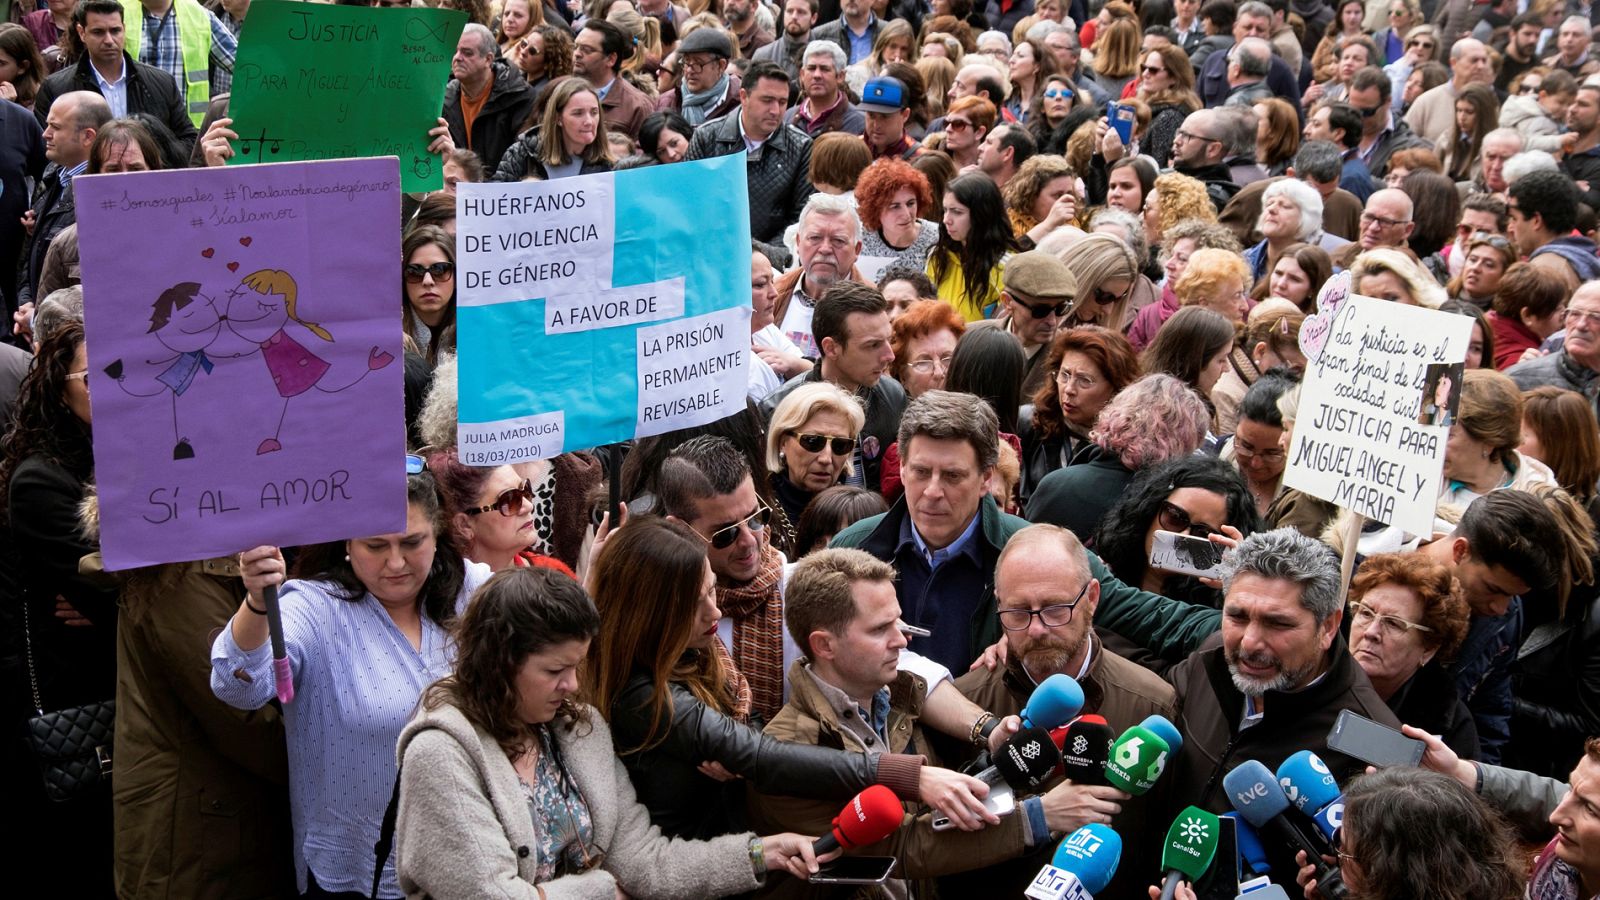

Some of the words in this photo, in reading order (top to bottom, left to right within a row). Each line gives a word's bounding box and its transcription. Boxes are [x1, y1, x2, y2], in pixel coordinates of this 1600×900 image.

[464, 190, 586, 217] HUÉRFANOS
[465, 235, 492, 253] DE
[498, 223, 599, 251] VIOLENCIA
[466, 271, 492, 289] DE
[498, 260, 576, 285] GÉNERO
[551, 311, 564, 327] A
[571, 301, 629, 325] FAVOR
[635, 297, 657, 315] DE
[643, 340, 662, 357] LA
[667, 323, 724, 352] PRISIÓN
[1336, 305, 1356, 345] La
[1359, 324, 1408, 356] justicia
[1412, 342, 1427, 358] es
[1433, 337, 1449, 361] el
[644, 350, 742, 390] PERMANENTE
[1317, 350, 1349, 378] gran
[1352, 357, 1391, 383] final
[1394, 361, 1408, 388] de
[643, 388, 724, 423] REVISABLE.
[1334, 380, 1386, 410] sociedad
[1393, 396, 1419, 421] civil
[464, 428, 497, 444] JULIA
[501, 422, 559, 442] MADRUGA
[1314, 403, 1393, 443] JUSTICIA
[1398, 426, 1438, 459] PARA
[465, 444, 542, 464] (18/03/2010)
[1293, 435, 1354, 477] MIGUEL
[1355, 450, 1406, 494] ANGEL
[142, 487, 180, 524] SÍ
[200, 490, 240, 518] AL
[260, 470, 352, 508] AMOR
[1332, 479, 1395, 525] MARIA
[1237, 781, 1269, 806] tve
